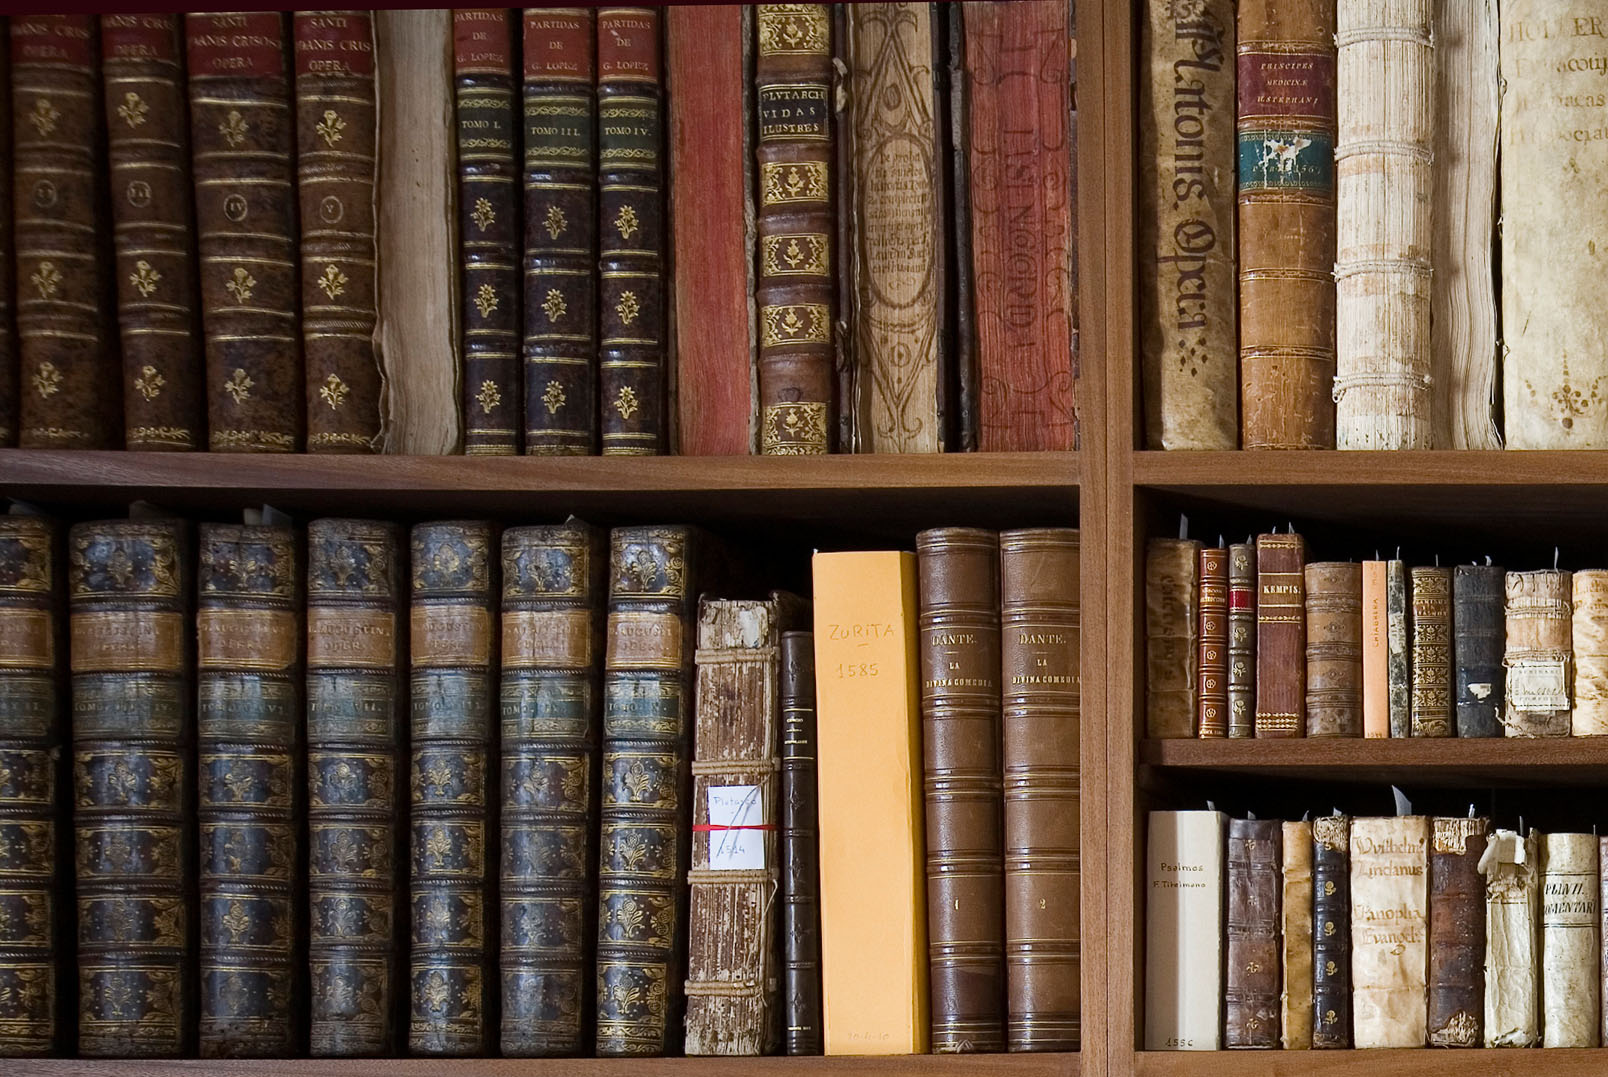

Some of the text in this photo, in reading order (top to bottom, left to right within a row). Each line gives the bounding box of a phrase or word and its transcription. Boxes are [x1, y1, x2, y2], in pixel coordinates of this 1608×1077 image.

[530, 21, 580, 31] PARTIDAS
[602, 20, 651, 31] PARTIDAS
[616, 37, 632, 47] DE
[531, 127, 558, 136] TOMO
[604, 126, 631, 136] TOMO
[763, 123, 819, 135] ILUSTRES
[931, 633, 977, 646] DANTE.
[1019, 633, 1067, 645] DANTE.
[837, 662, 880, 679] 1585
